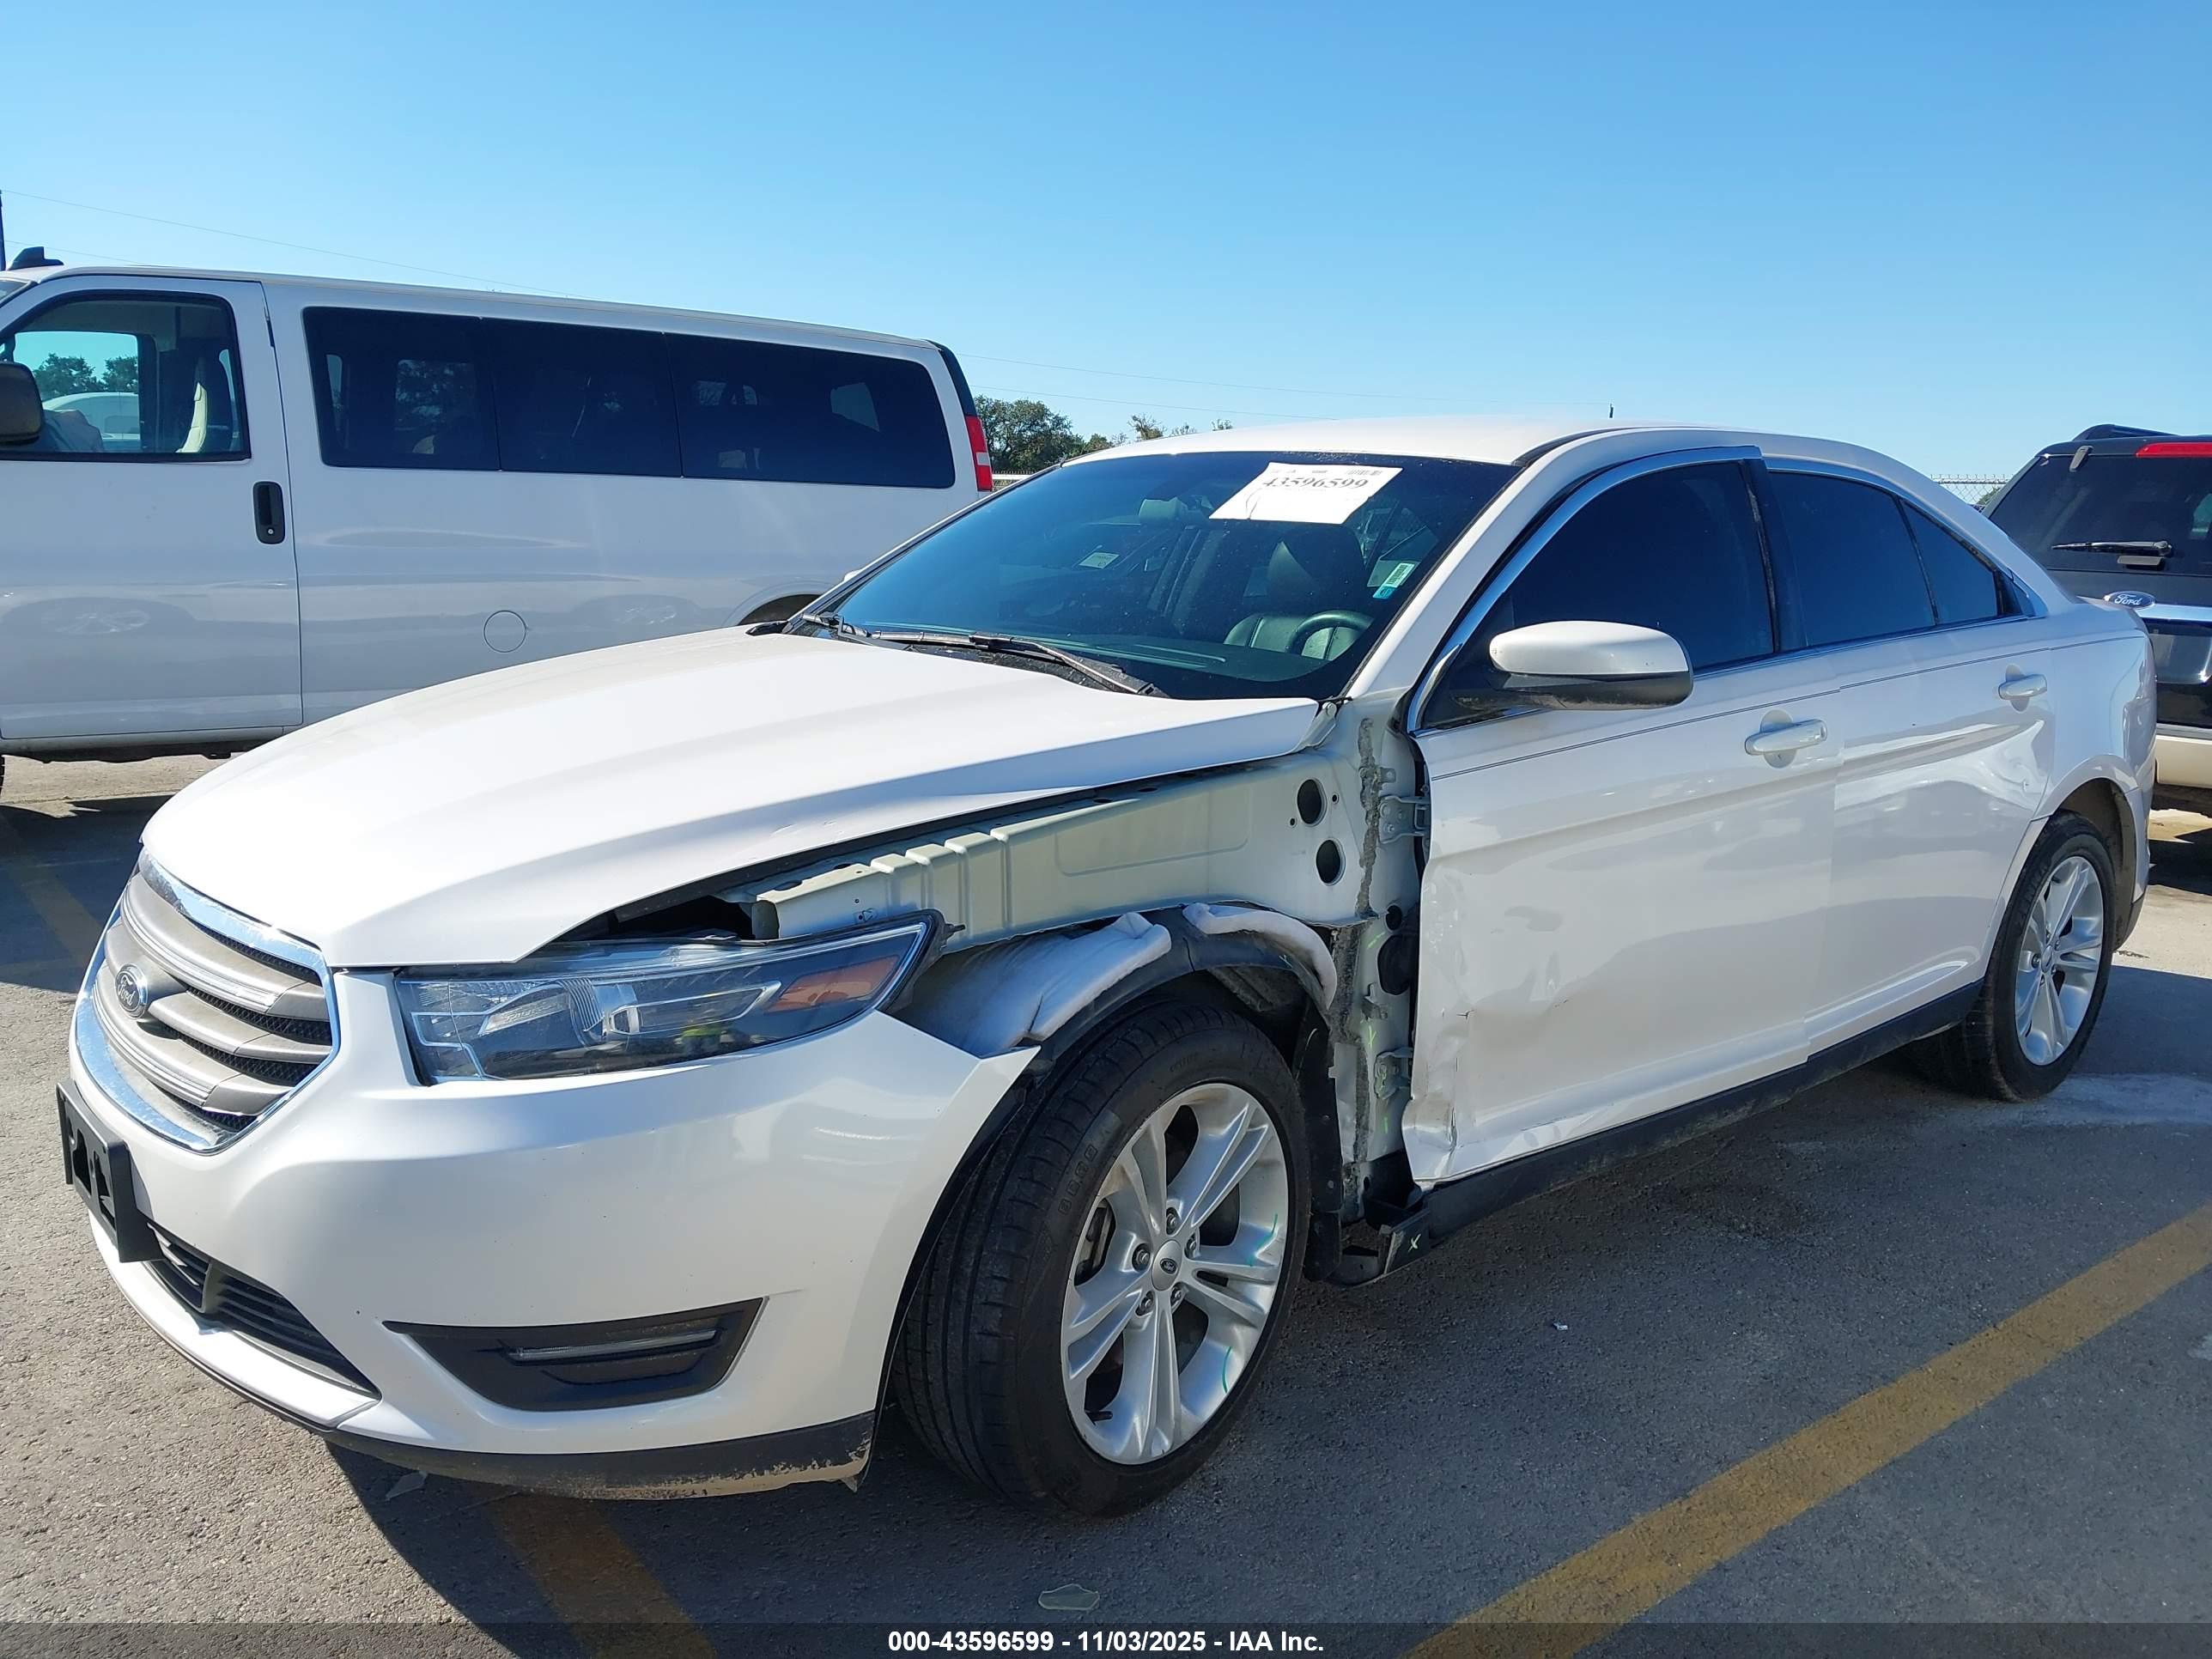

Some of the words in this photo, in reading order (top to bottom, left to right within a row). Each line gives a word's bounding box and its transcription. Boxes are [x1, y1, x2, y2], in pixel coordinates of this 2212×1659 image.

[1263, 477, 1369, 489] 43596599
[2114, 593, 2143, 605] Ford
[118, 975, 136, 1006] Ford
